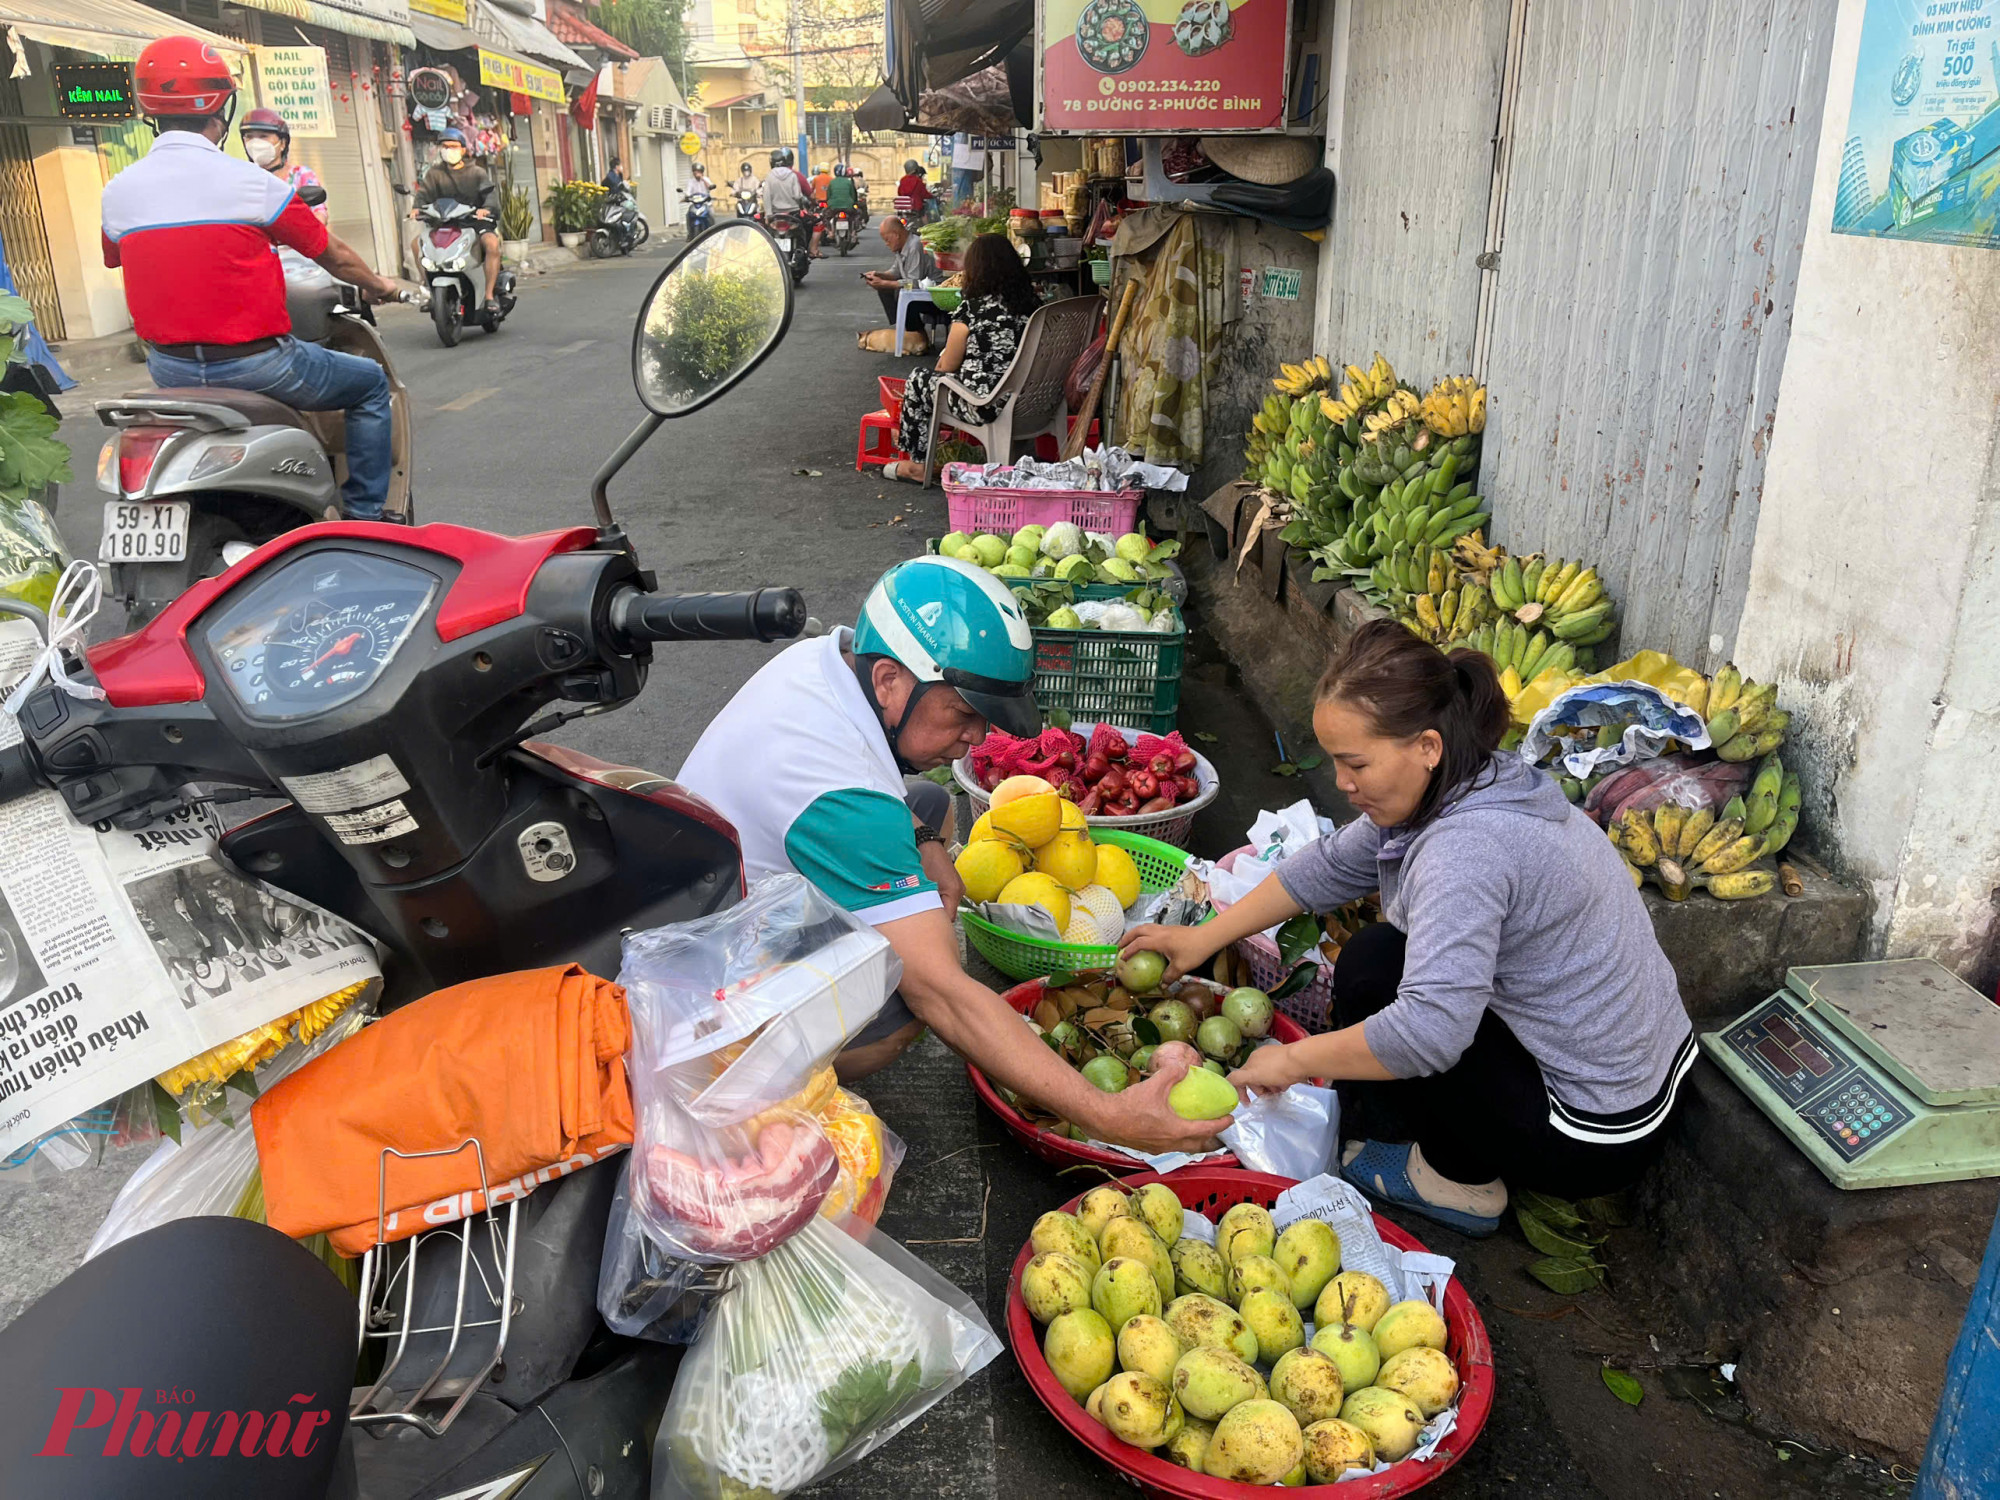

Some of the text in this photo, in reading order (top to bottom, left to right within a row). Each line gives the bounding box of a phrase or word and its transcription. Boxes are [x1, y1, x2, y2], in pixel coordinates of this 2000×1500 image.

[1927, 4, 1938, 17] 03
[1938, 1, 1959, 15] HUY
[1912, 15, 1992, 36] ĐÍNH KIM CƯƠNG
[1947, 38, 1976, 54] Trị giá
[274, 52, 302, 61] NAIL
[264, 67, 315, 76] MAKEUP
[1942, 55, 1974, 76] 500
[416, 77, 445, 91] Nail
[1118, 80, 1221, 93] 0902.234.220
[95, 89, 124, 103] NAIL
[299, 96, 314, 105] MI
[1063, 95, 1262, 111] 78 ĐƯỜNG 2-PHƯỚC BÌNH
[278, 108, 318, 120] ỐN MI
[117, 506, 173, 529] 59-X1
[109, 533, 180, 557] 180.90
[897, 597, 938, 649] BOSTON PHARMA
[258, 691, 268, 702] N
[338, 954, 367, 969] Thời sự
[25, 982, 83, 1020] trước
[29, 1014, 78, 1049] diễn
[87, 1010, 150, 1052] Khẩu
[8, 1037, 31, 1060] ra
[28, 1040, 86, 1082] chiến
[12, 1108, 31, 1125] Quốc
[1326, 1198, 1346, 1213] 나선
